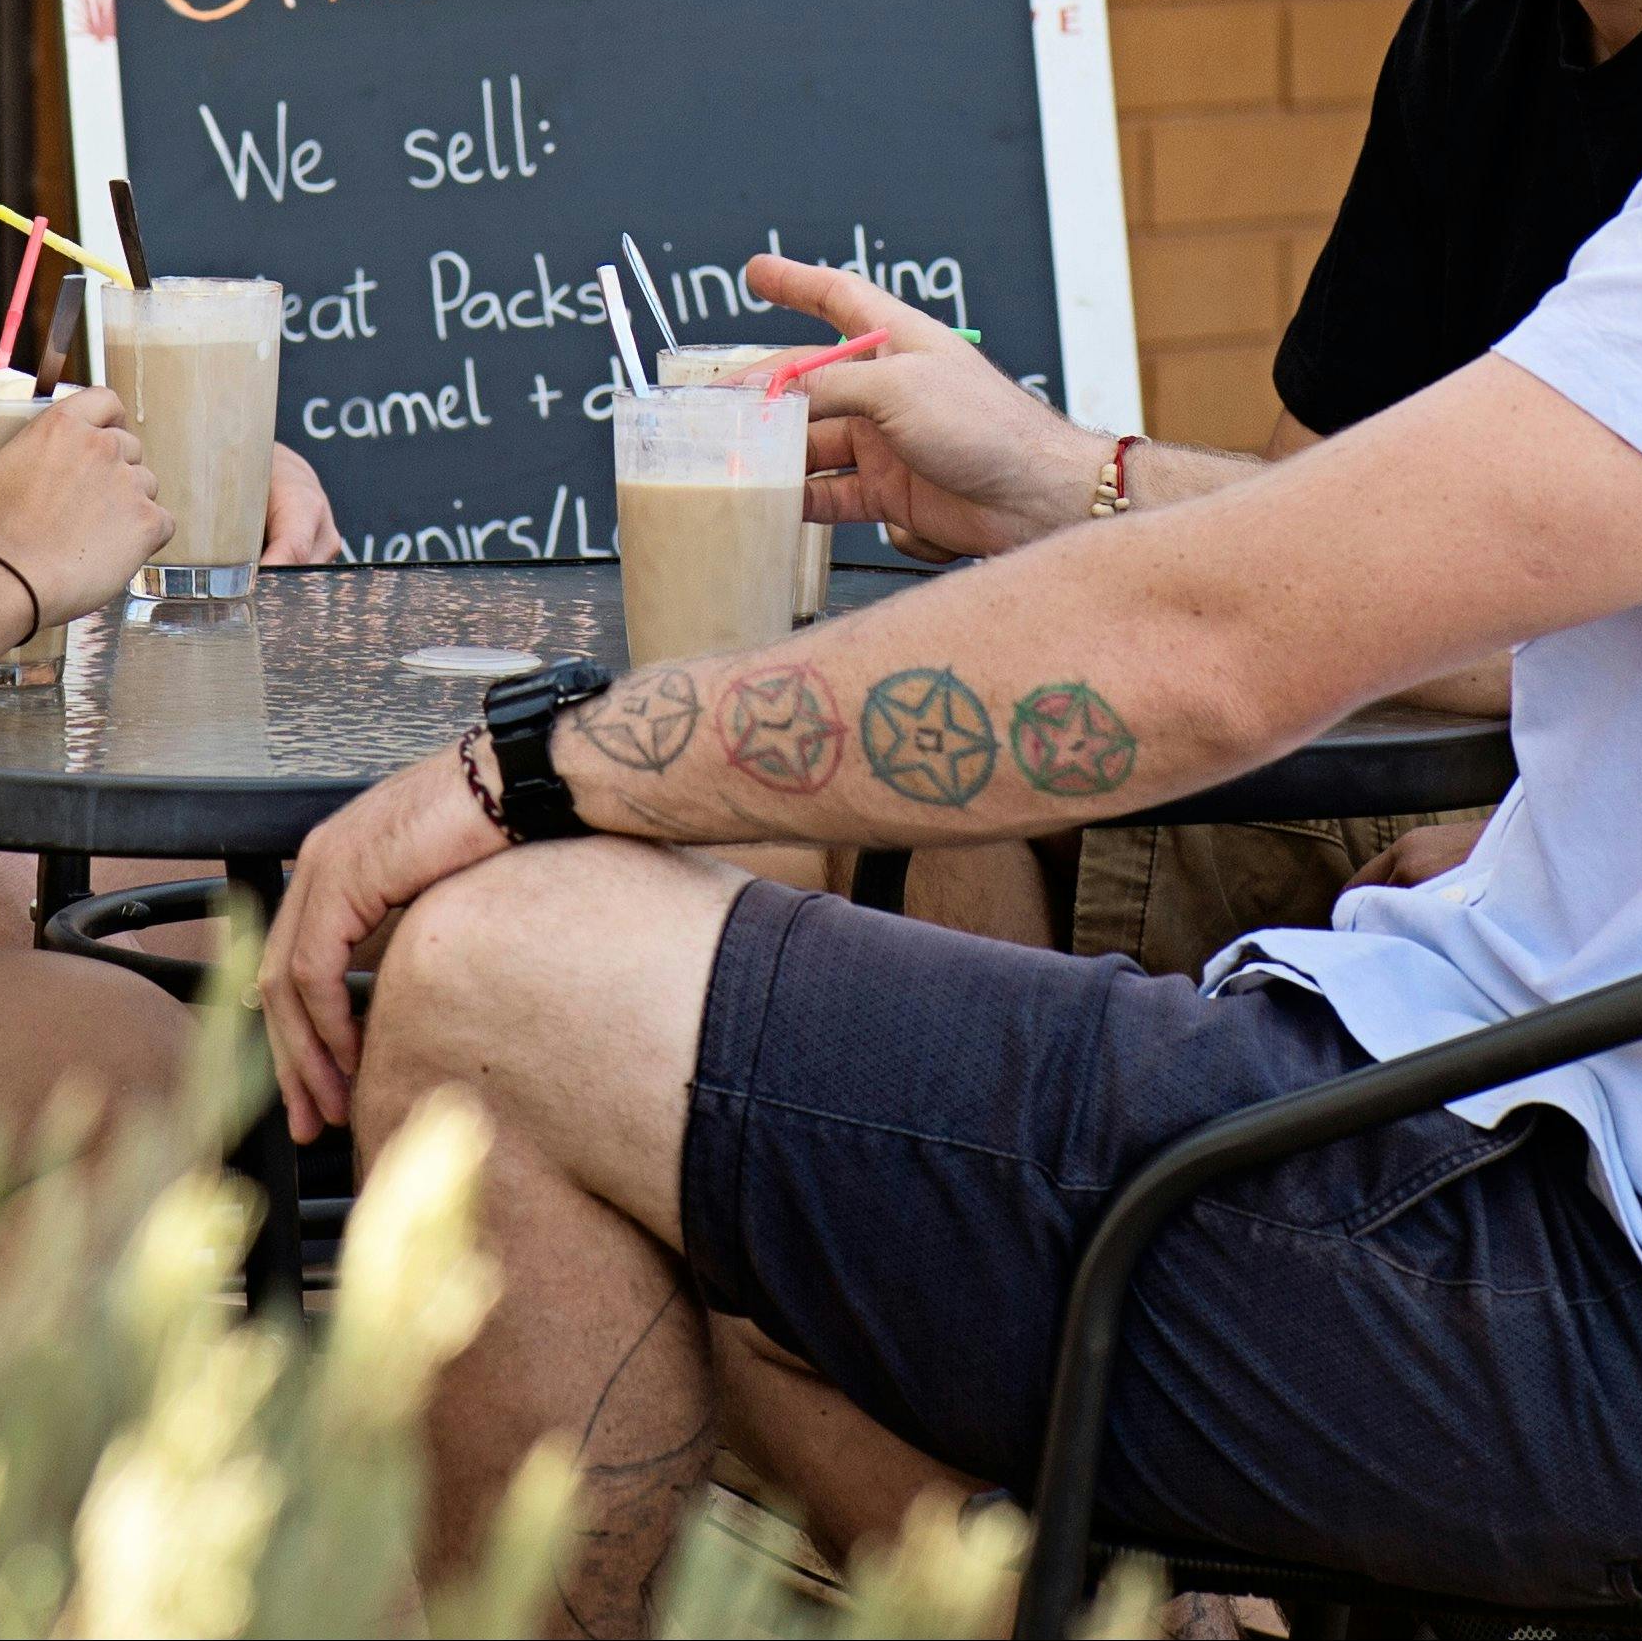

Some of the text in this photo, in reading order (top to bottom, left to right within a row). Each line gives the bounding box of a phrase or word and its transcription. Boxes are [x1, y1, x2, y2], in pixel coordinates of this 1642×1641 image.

[198, 73, 557, 202] We sell:
[277, 267, 380, 343] eat
[302, 356, 492, 440] camel
[527, 373, 564, 419] +
